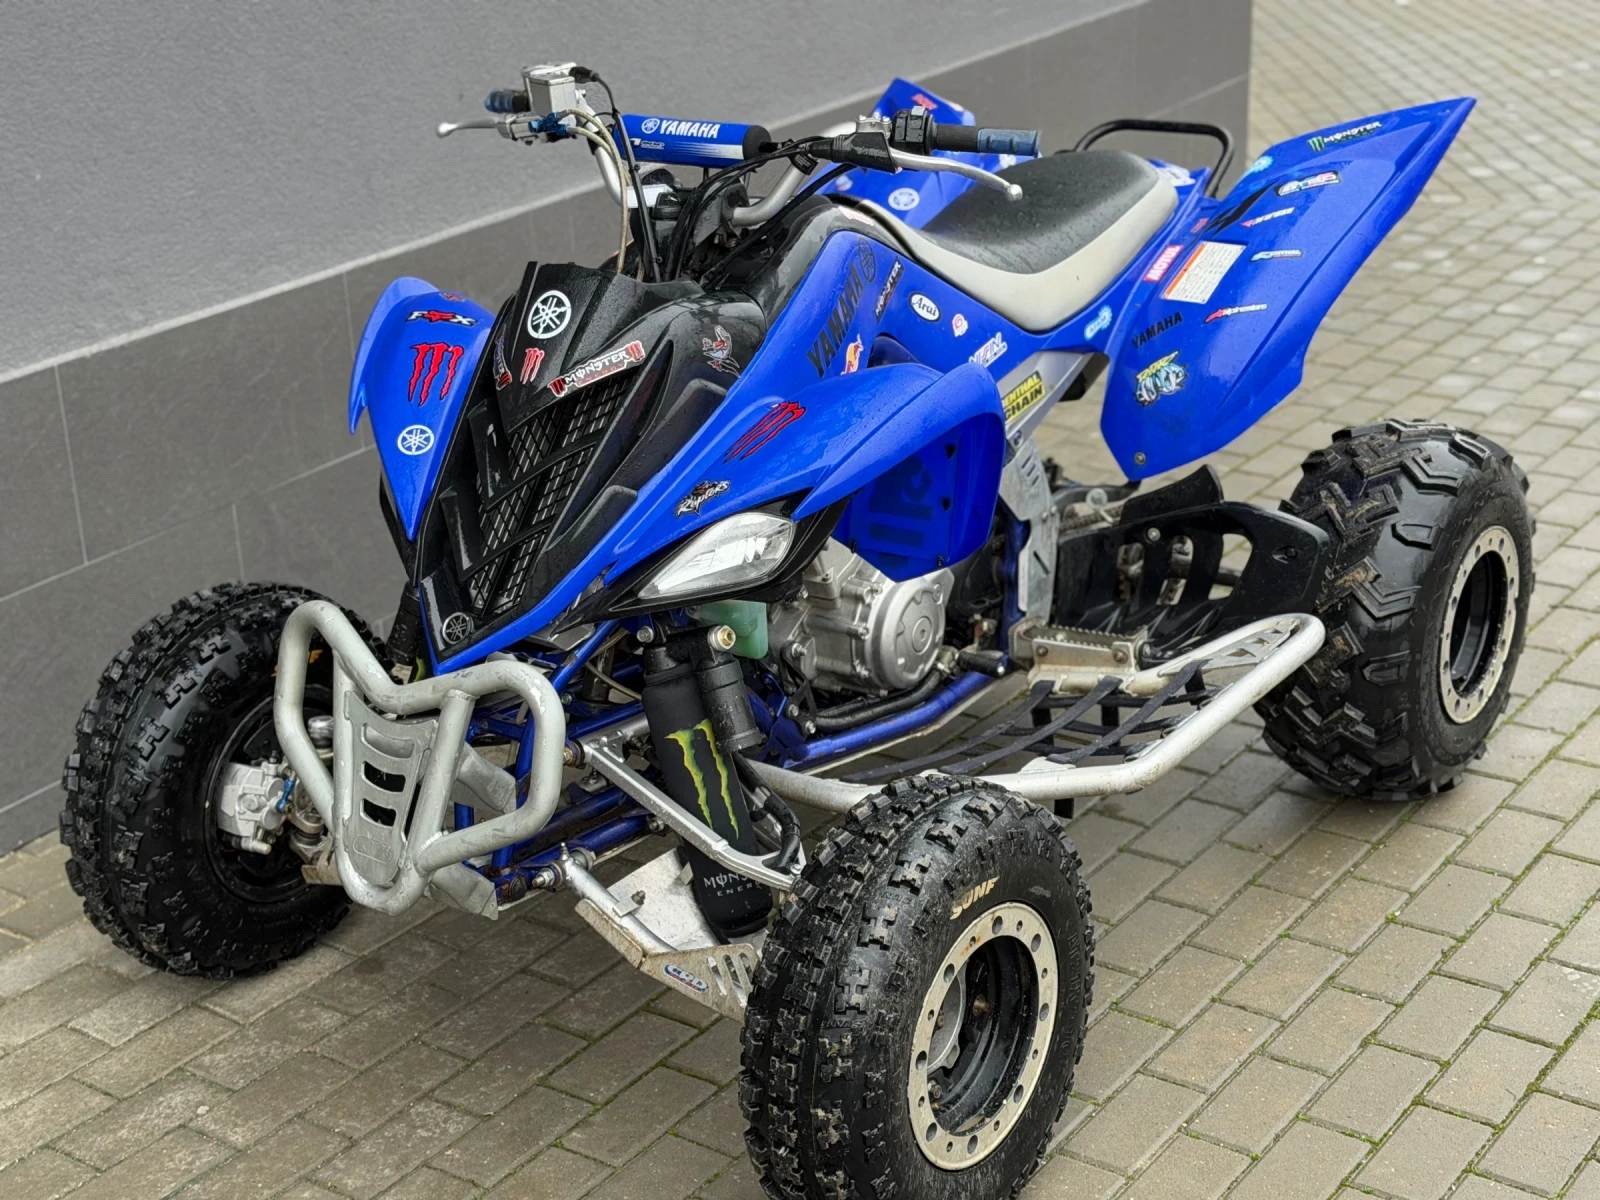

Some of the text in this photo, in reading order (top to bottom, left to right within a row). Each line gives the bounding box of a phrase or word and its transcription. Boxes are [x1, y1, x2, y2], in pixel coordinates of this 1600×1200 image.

[660, 119, 720, 139] YAMAHA
[1147, 244, 1181, 280] MOTUL
[407, 310, 478, 326] FOX
[807, 263, 864, 378] YAMAHA
[912, 297, 938, 317] Arai
[1131, 311, 1183, 349] YAMAHA
[565, 350, 631, 384] MONSTER
[1005, 384, 1043, 420] CHAIN
